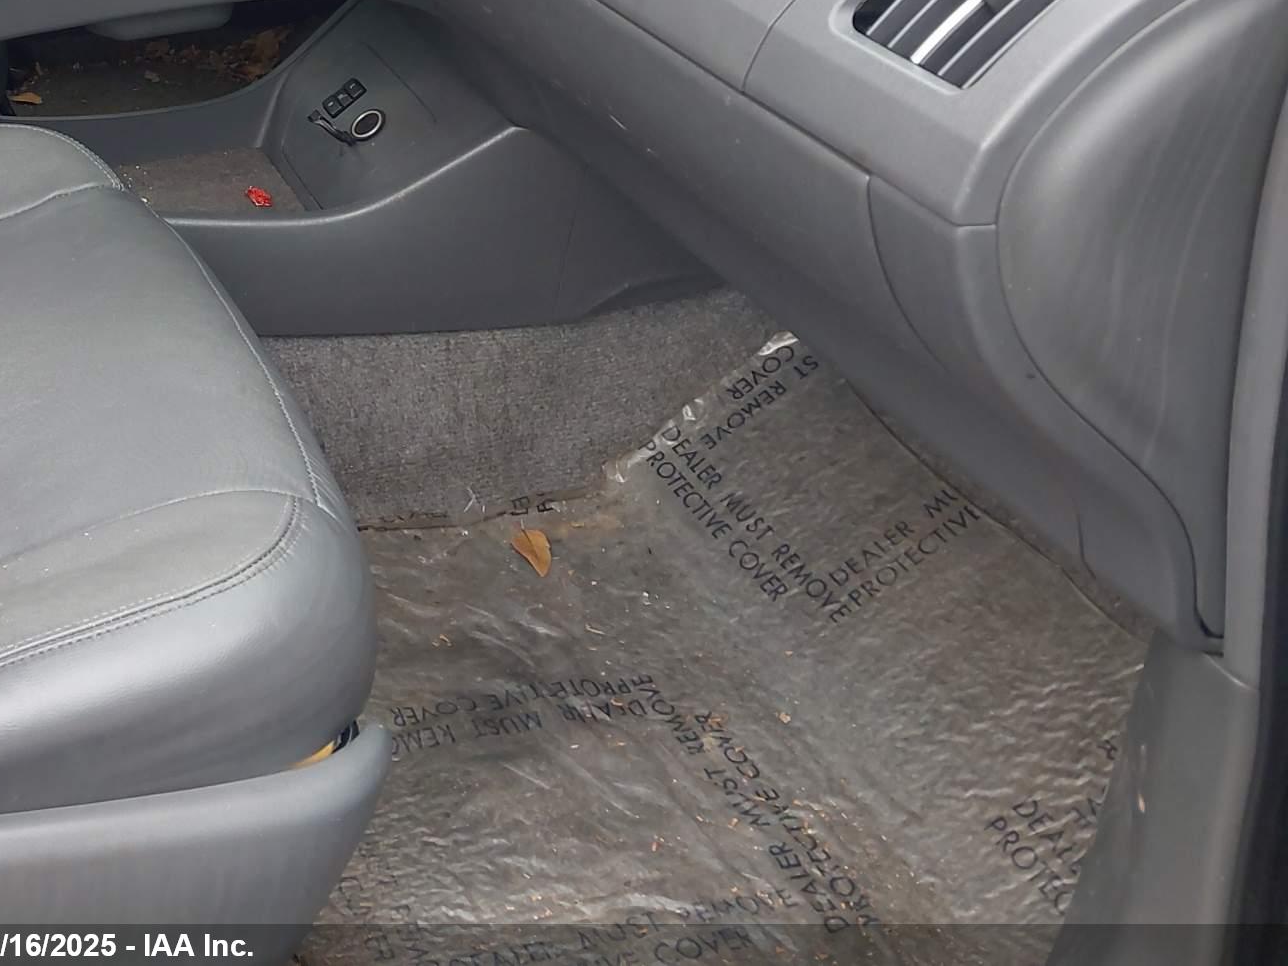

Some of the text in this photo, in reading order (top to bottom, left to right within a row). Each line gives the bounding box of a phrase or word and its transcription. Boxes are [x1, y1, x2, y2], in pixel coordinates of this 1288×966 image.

[727, 345, 795, 400] COVER
[700, 380, 787, 450] REMOVE
[638, 440, 789, 603] PROTECTIVE COVER
[661, 424, 854, 624] DEALER MUST REMOVE
[828, 519, 915, 587] DEALER
[390, 697, 477, 727] COVER
[471, 710, 544, 739] MUST
[768, 841, 851, 934] DEALER
